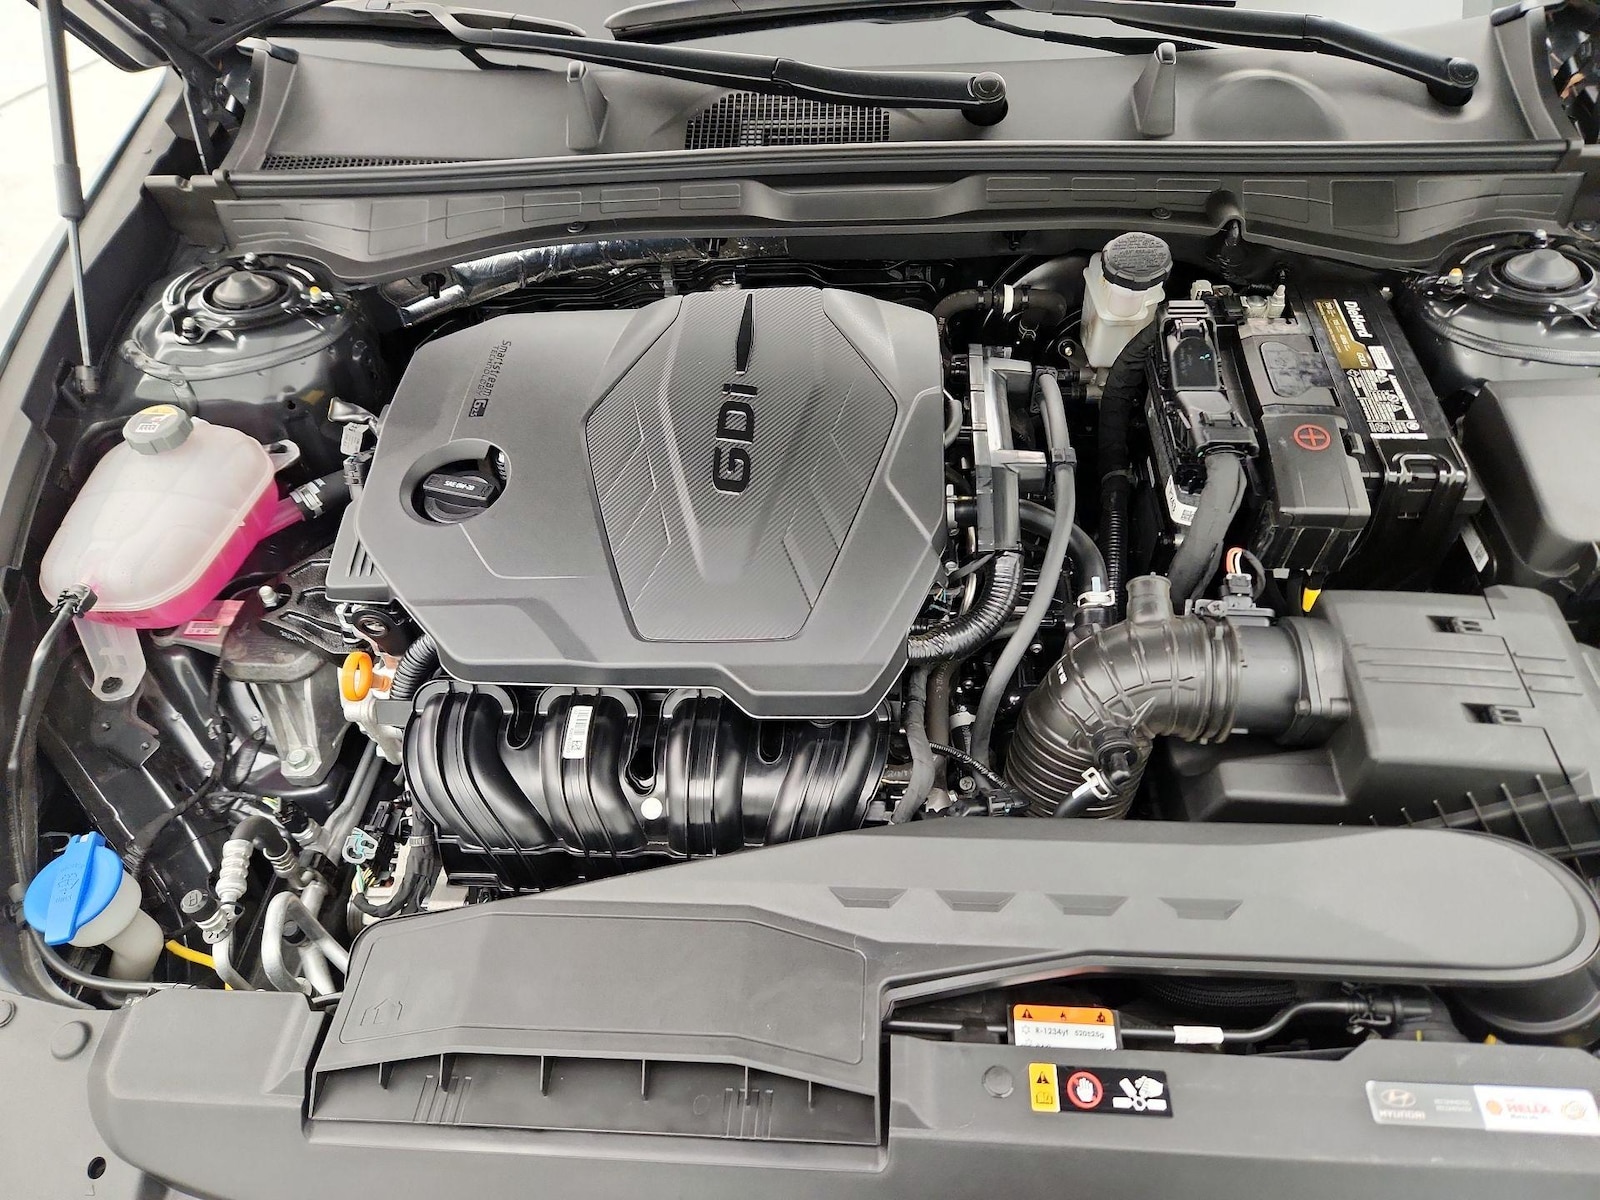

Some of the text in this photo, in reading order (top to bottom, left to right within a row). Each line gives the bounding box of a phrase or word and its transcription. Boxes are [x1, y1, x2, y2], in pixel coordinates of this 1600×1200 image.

[1344, 301, 1373, 338] DieHard
[476, 345, 500, 396] TECHNOLOGY
[483, 340, 512, 397] Smartstream
[1356, 352, 1369, 368] GOLD
[1035, 1026, 1069, 1038] R-1234yf
[1378, 1109, 1427, 1120] HYUNDAI
